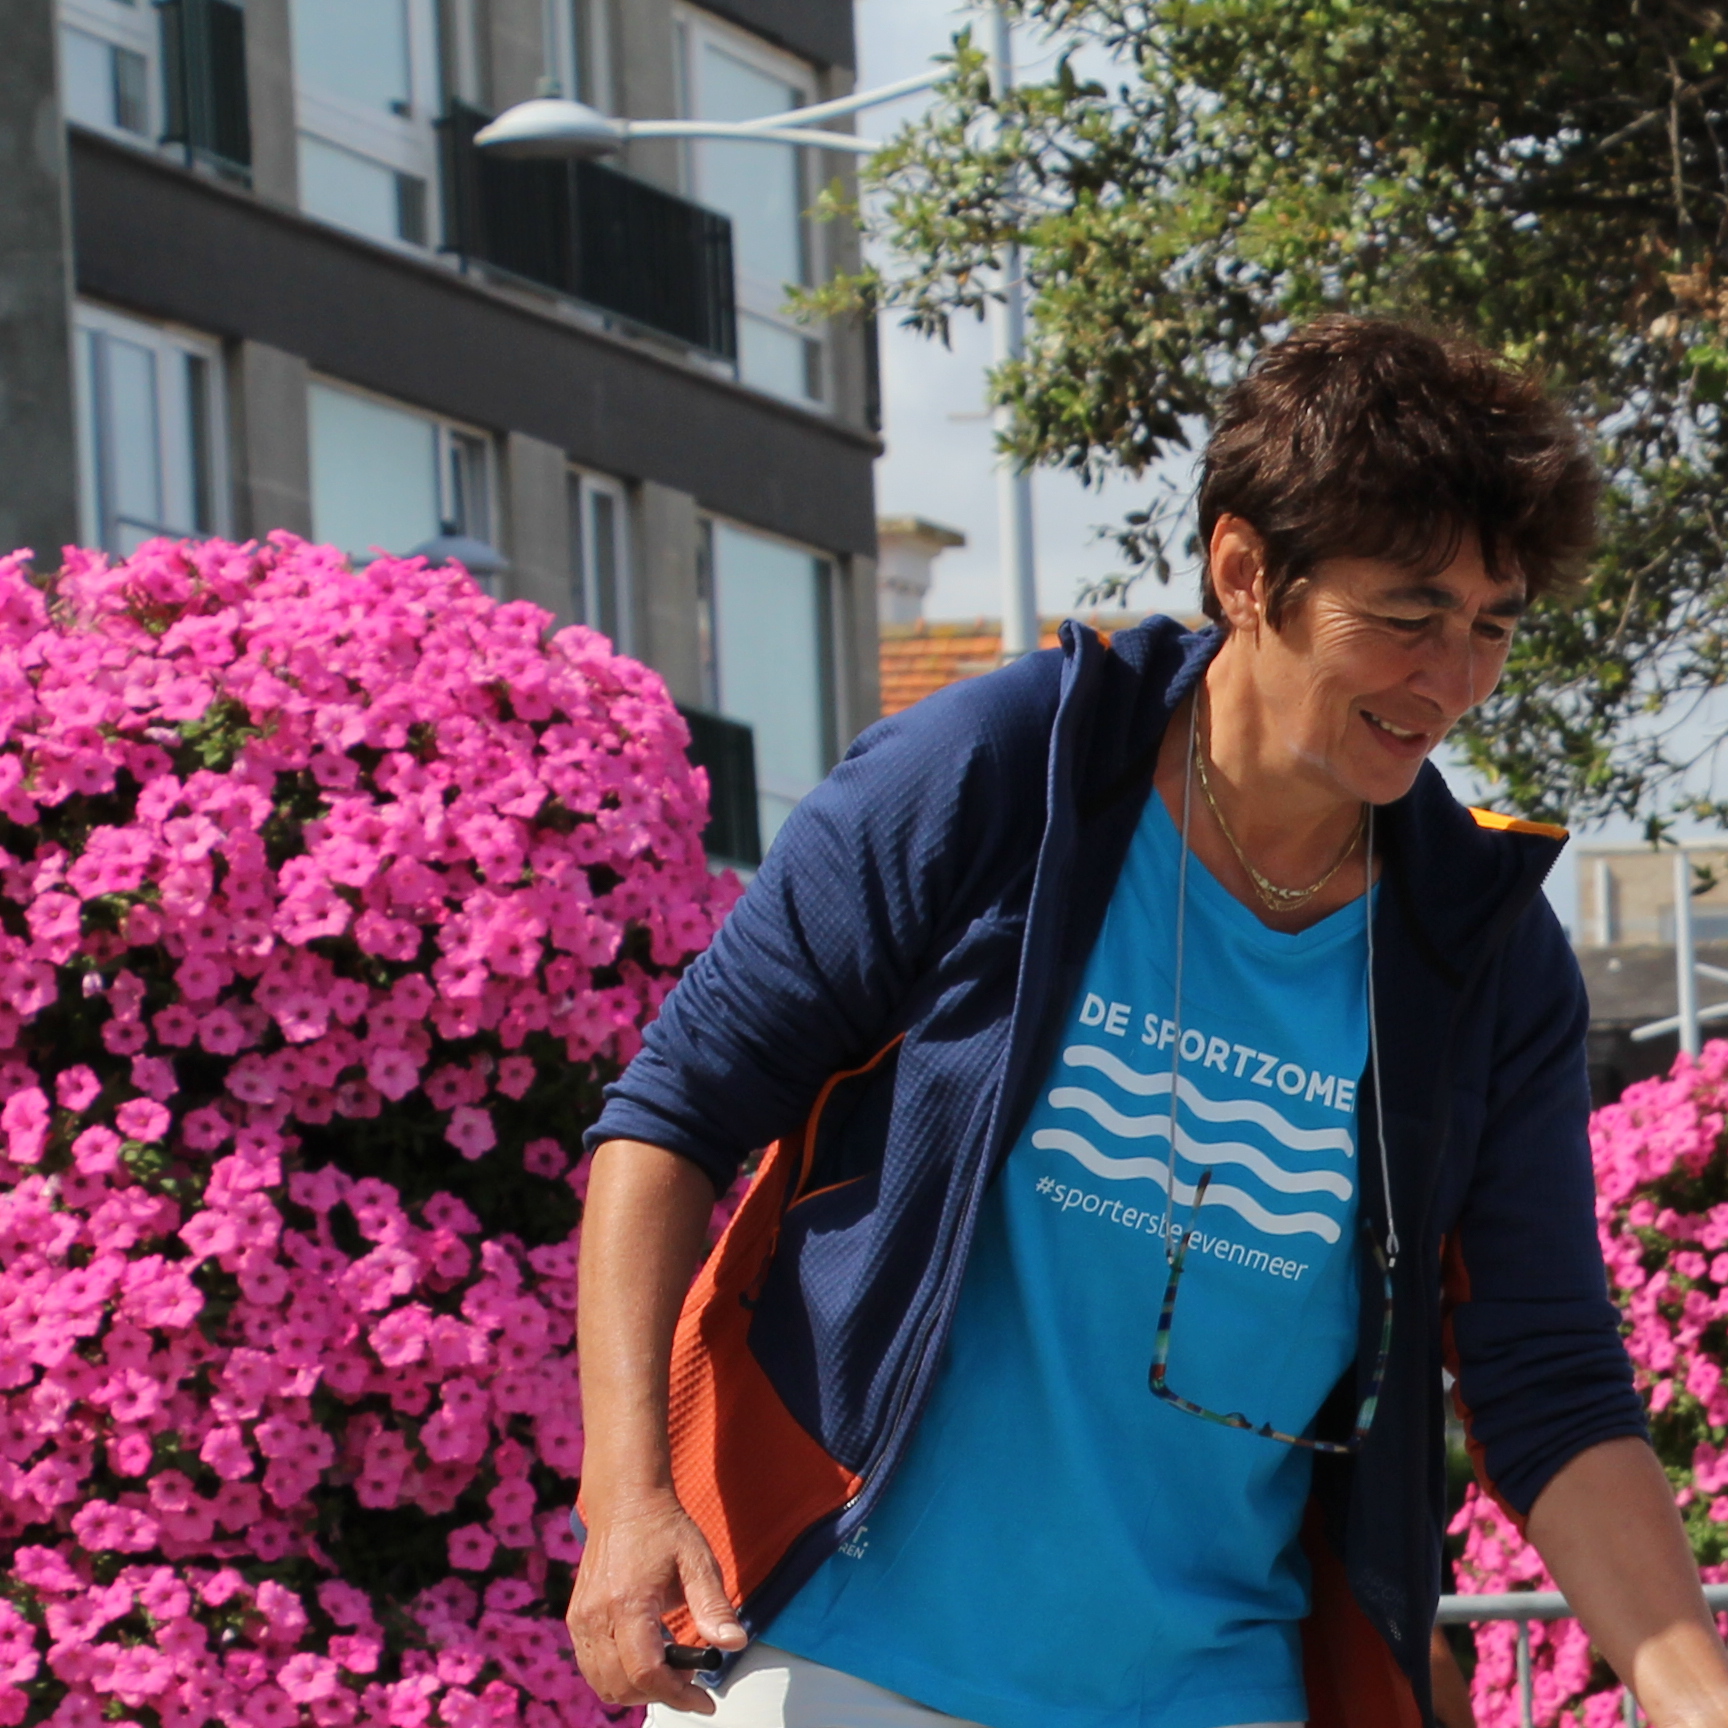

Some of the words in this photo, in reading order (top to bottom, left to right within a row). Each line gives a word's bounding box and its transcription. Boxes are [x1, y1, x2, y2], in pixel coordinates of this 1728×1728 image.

[1078, 992, 1131, 1038] DE
[1140, 1013, 1355, 1114] SPORTZOME
[1035, 1174, 1309, 1282] #sportersbeevenmeer
